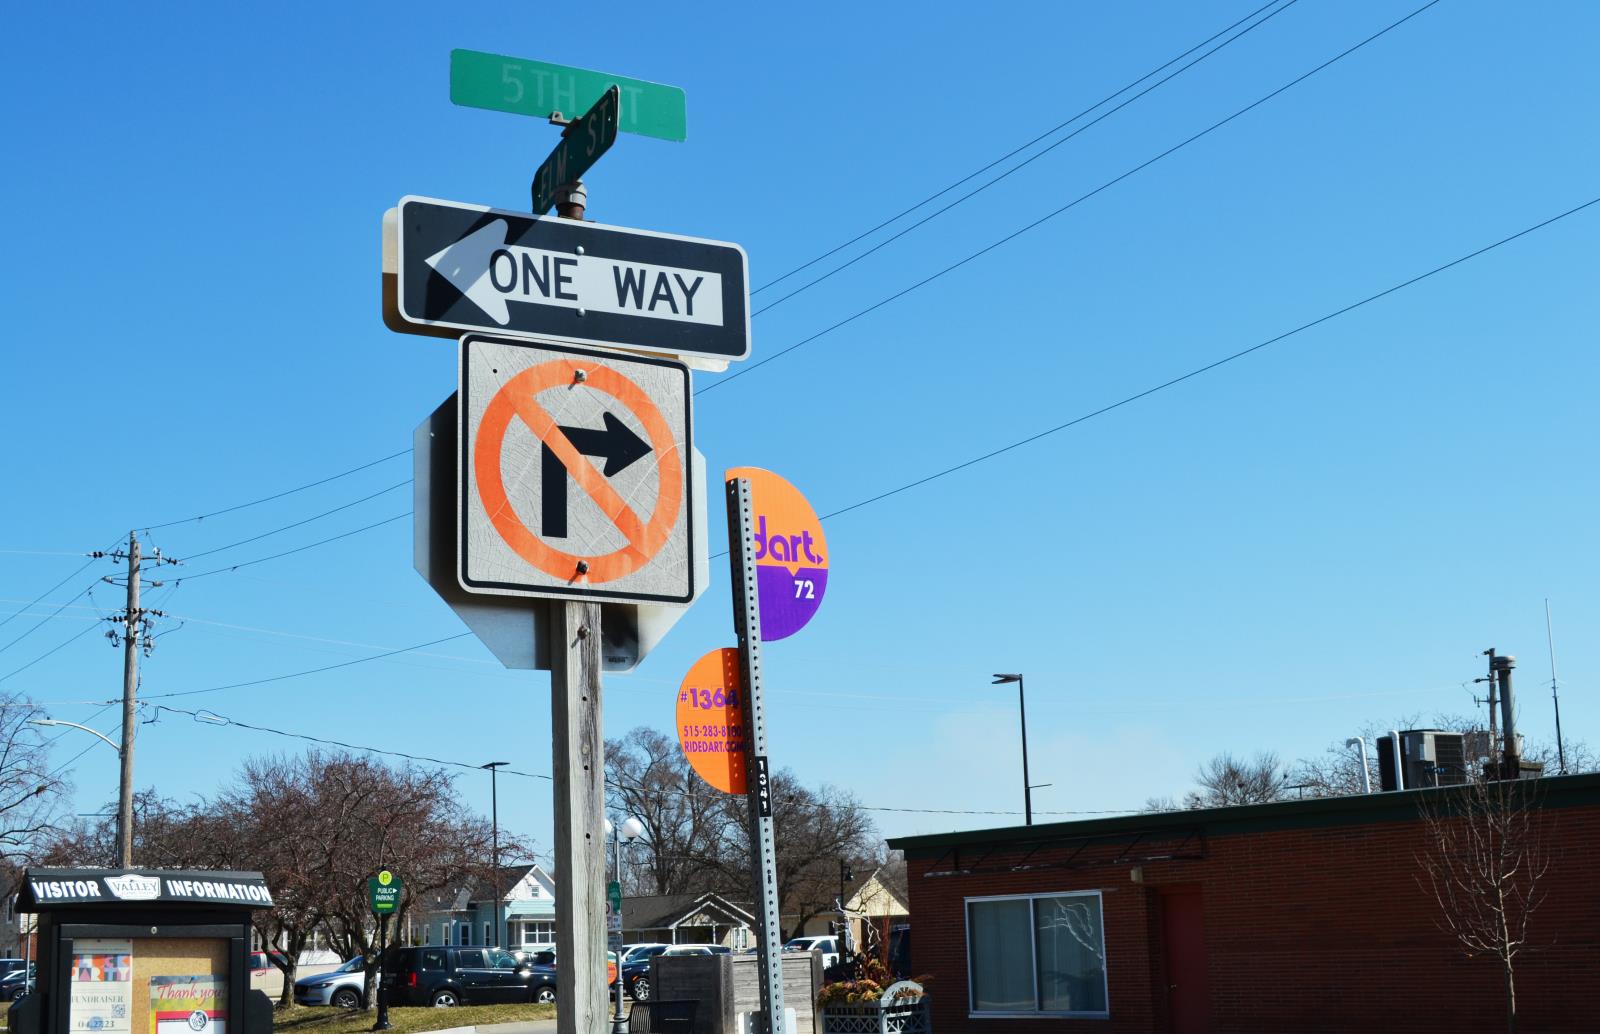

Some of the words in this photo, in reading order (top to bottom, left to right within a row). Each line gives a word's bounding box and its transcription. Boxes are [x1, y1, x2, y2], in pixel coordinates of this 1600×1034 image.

[502, 63, 576, 114] 5TH
[541, 140, 568, 209] ELM
[586, 99, 609, 157] ST
[489, 249, 578, 301] ONE
[613, 265, 704, 316] WAY
[794, 579, 815, 599] 72
[32, 881, 101, 898] VISITOR
[166, 879, 273, 902] INFORMATION
[112, 881, 158, 892] VALLEY
[157, 982, 197, 1000] Thank
